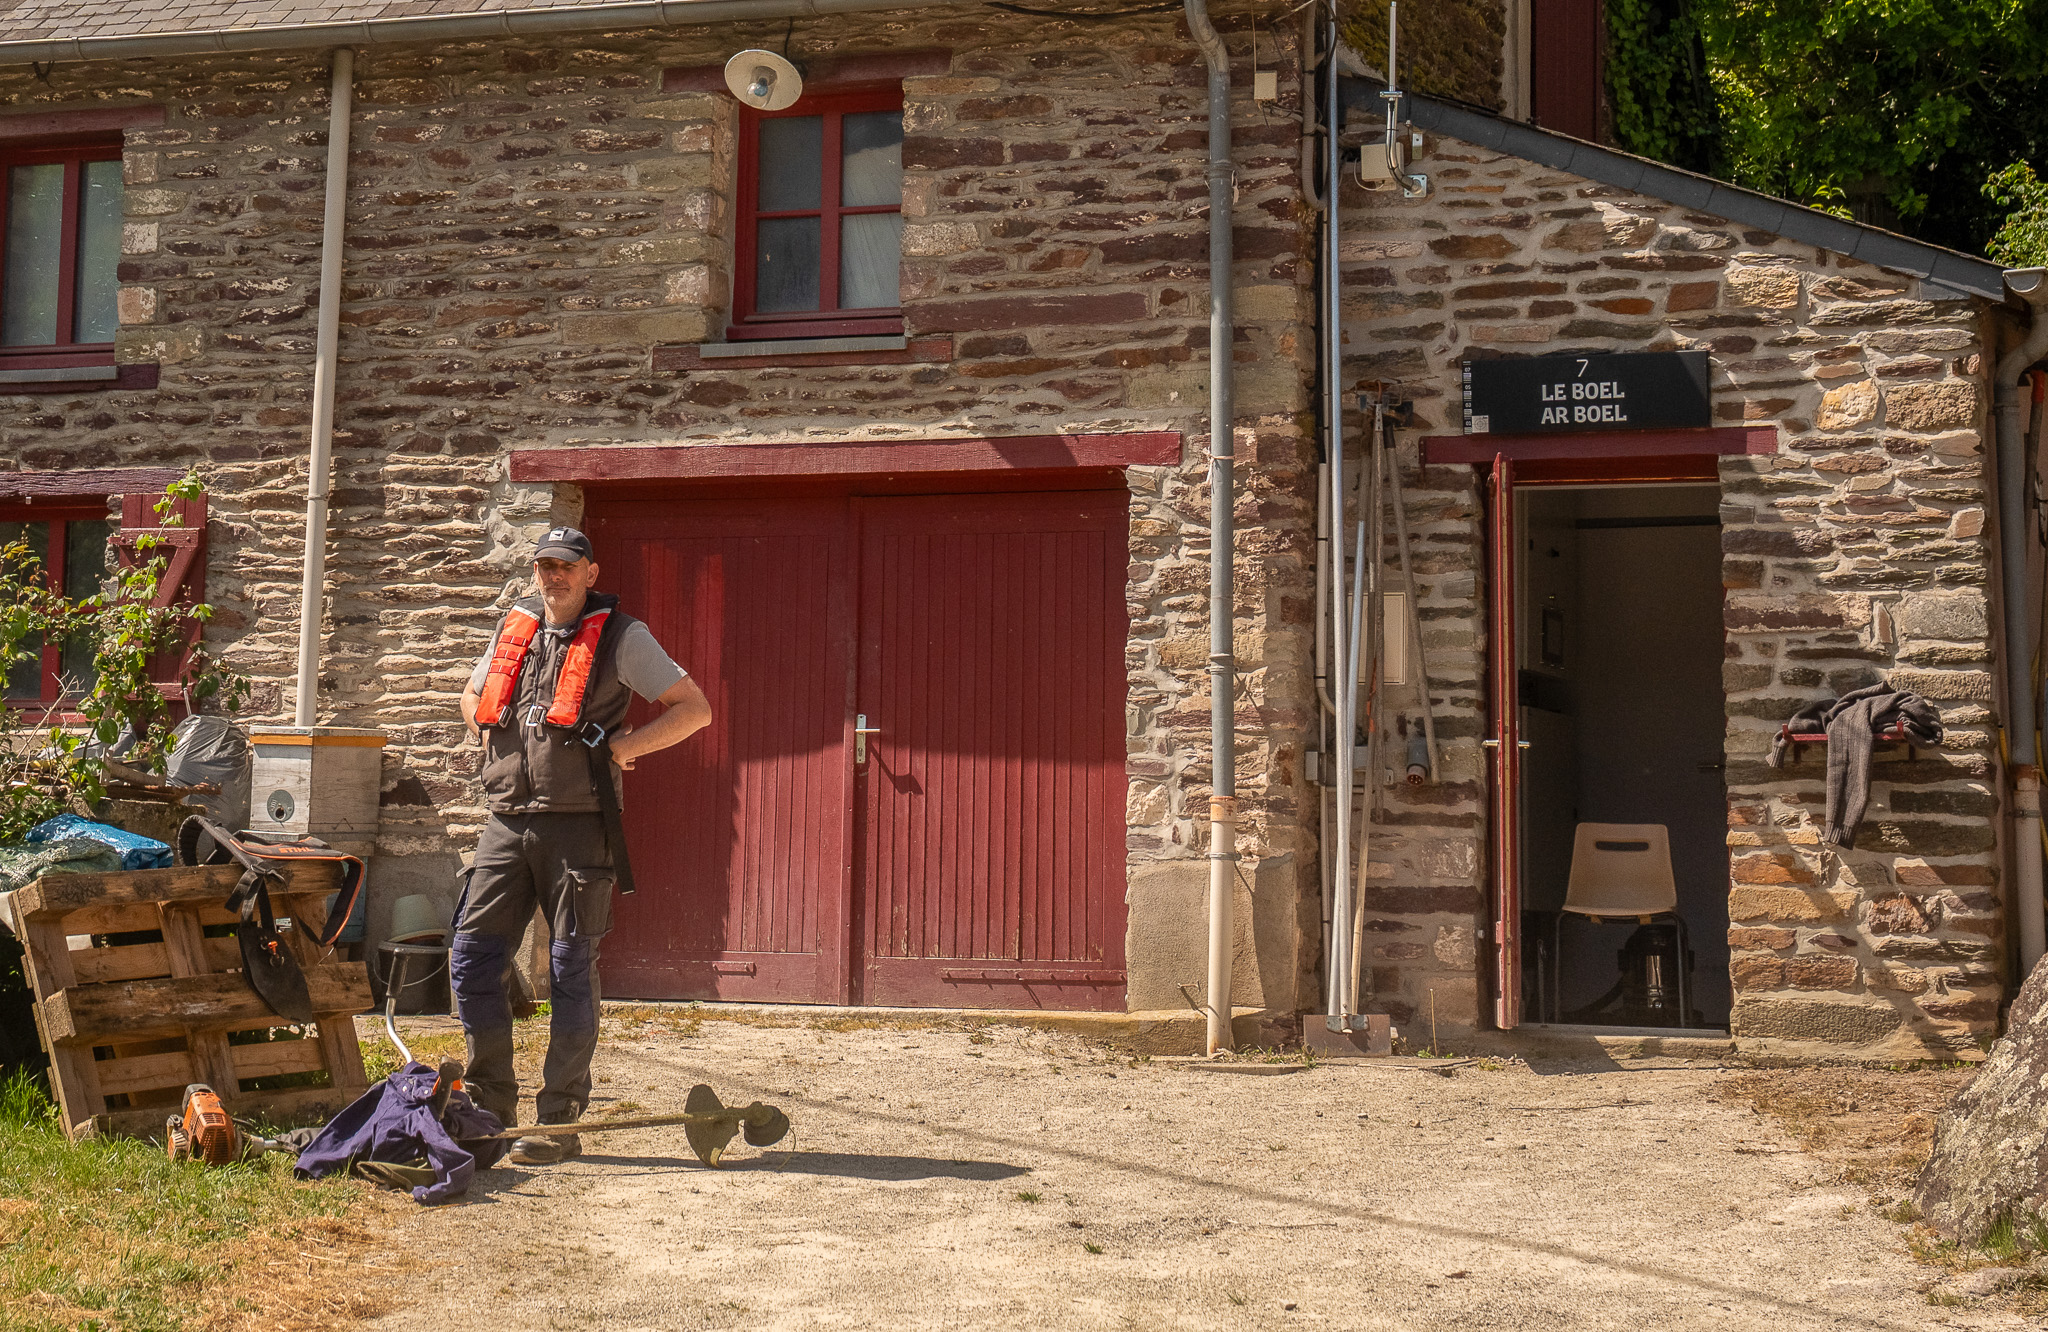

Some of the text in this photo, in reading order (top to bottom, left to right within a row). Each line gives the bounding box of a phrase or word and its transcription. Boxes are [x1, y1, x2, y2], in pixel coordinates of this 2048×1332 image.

[1576, 358, 1589, 378] 7
[1541, 381, 1626, 402] LE BOEL
[1541, 404, 1628, 425] AR BOEL
